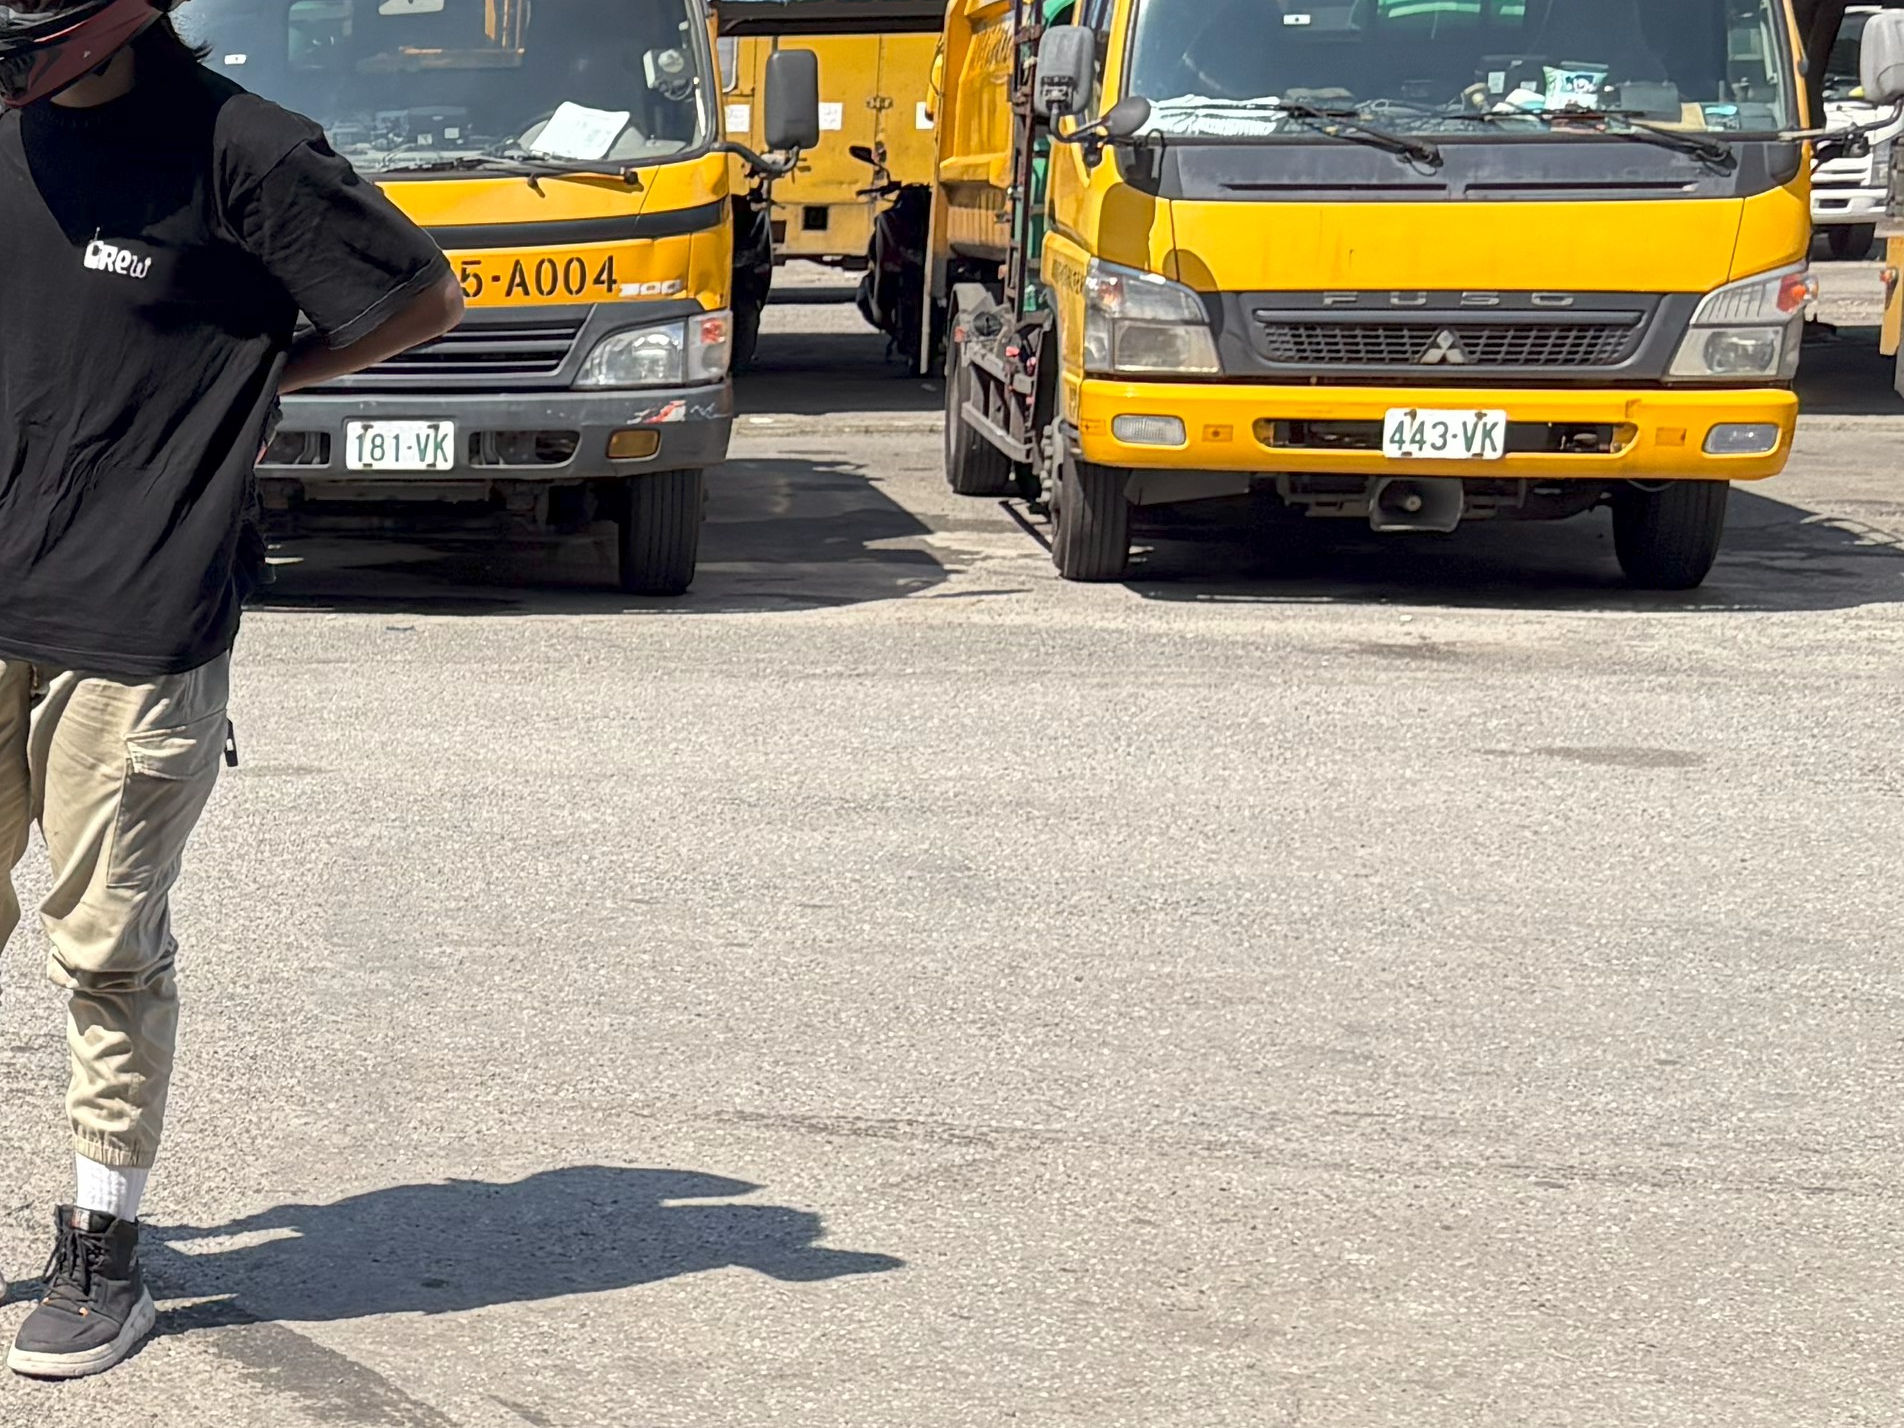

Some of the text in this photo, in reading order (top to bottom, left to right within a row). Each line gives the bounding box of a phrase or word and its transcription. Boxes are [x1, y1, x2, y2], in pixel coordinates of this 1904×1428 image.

[1322, 291, 1574, 306] FUSO
[355, 432, 449, 463] 181-VK
[1389, 420, 1498, 452] 443-VK
